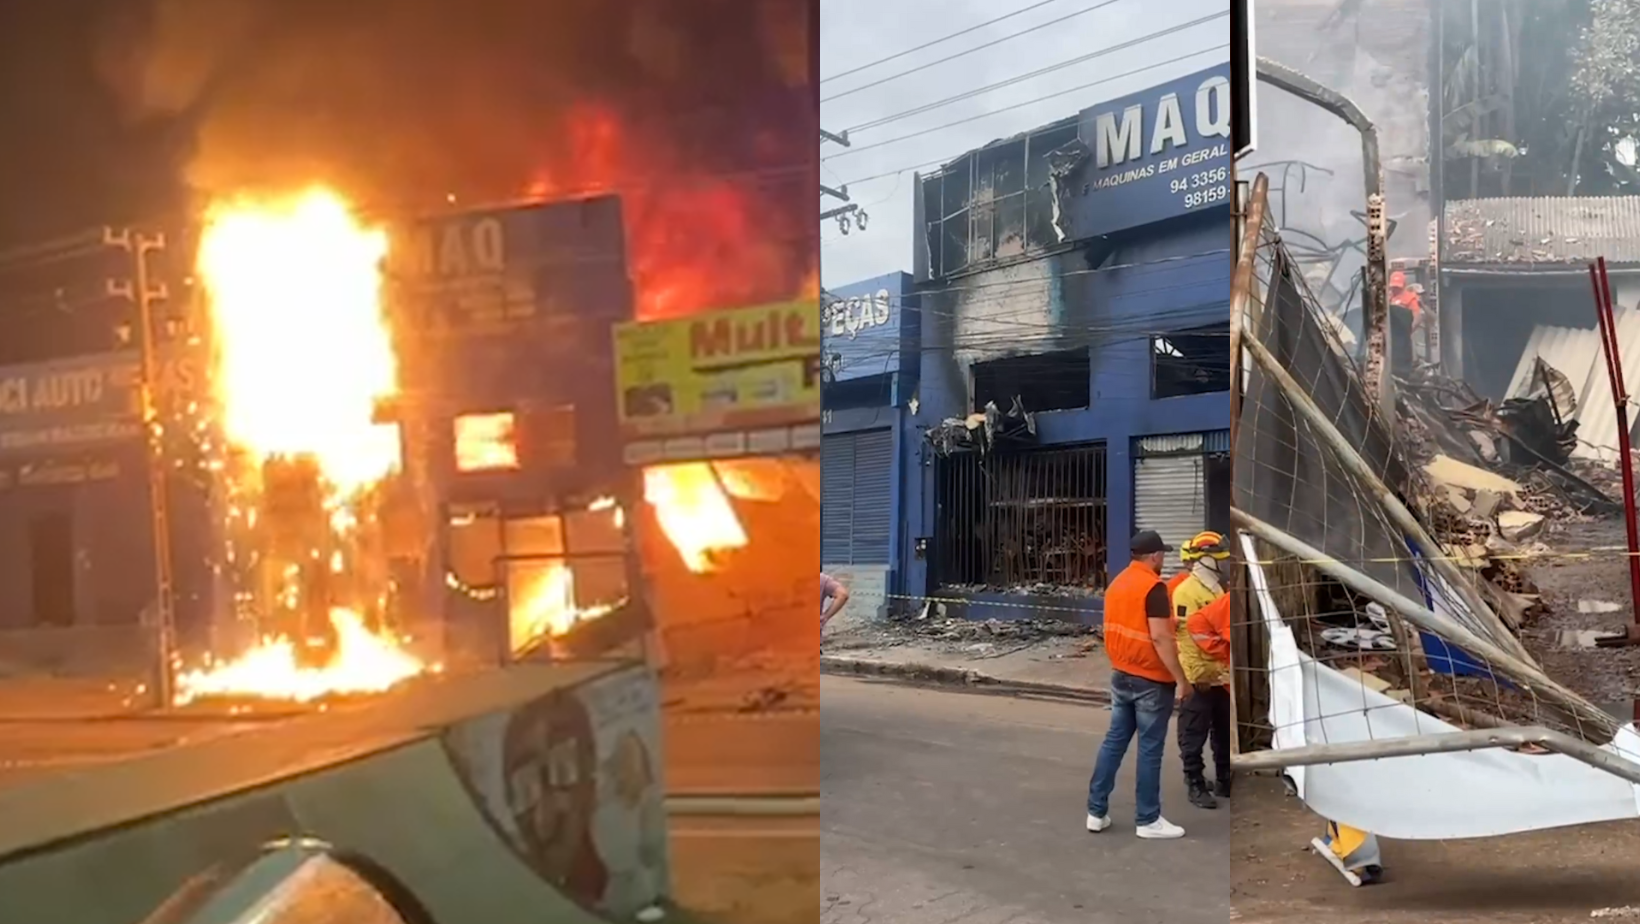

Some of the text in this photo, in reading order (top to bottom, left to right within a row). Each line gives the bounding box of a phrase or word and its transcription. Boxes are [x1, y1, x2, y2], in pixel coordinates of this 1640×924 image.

[1096, 75, 1230, 169] MAQ
[1093, 164, 1154, 192] MAQUINAS
[1158, 157, 1178, 174] EM
[1181, 144, 1227, 167] GERAL
[1170, 178, 1188, 194] 94
[33, 368, 102, 409] AUTO
